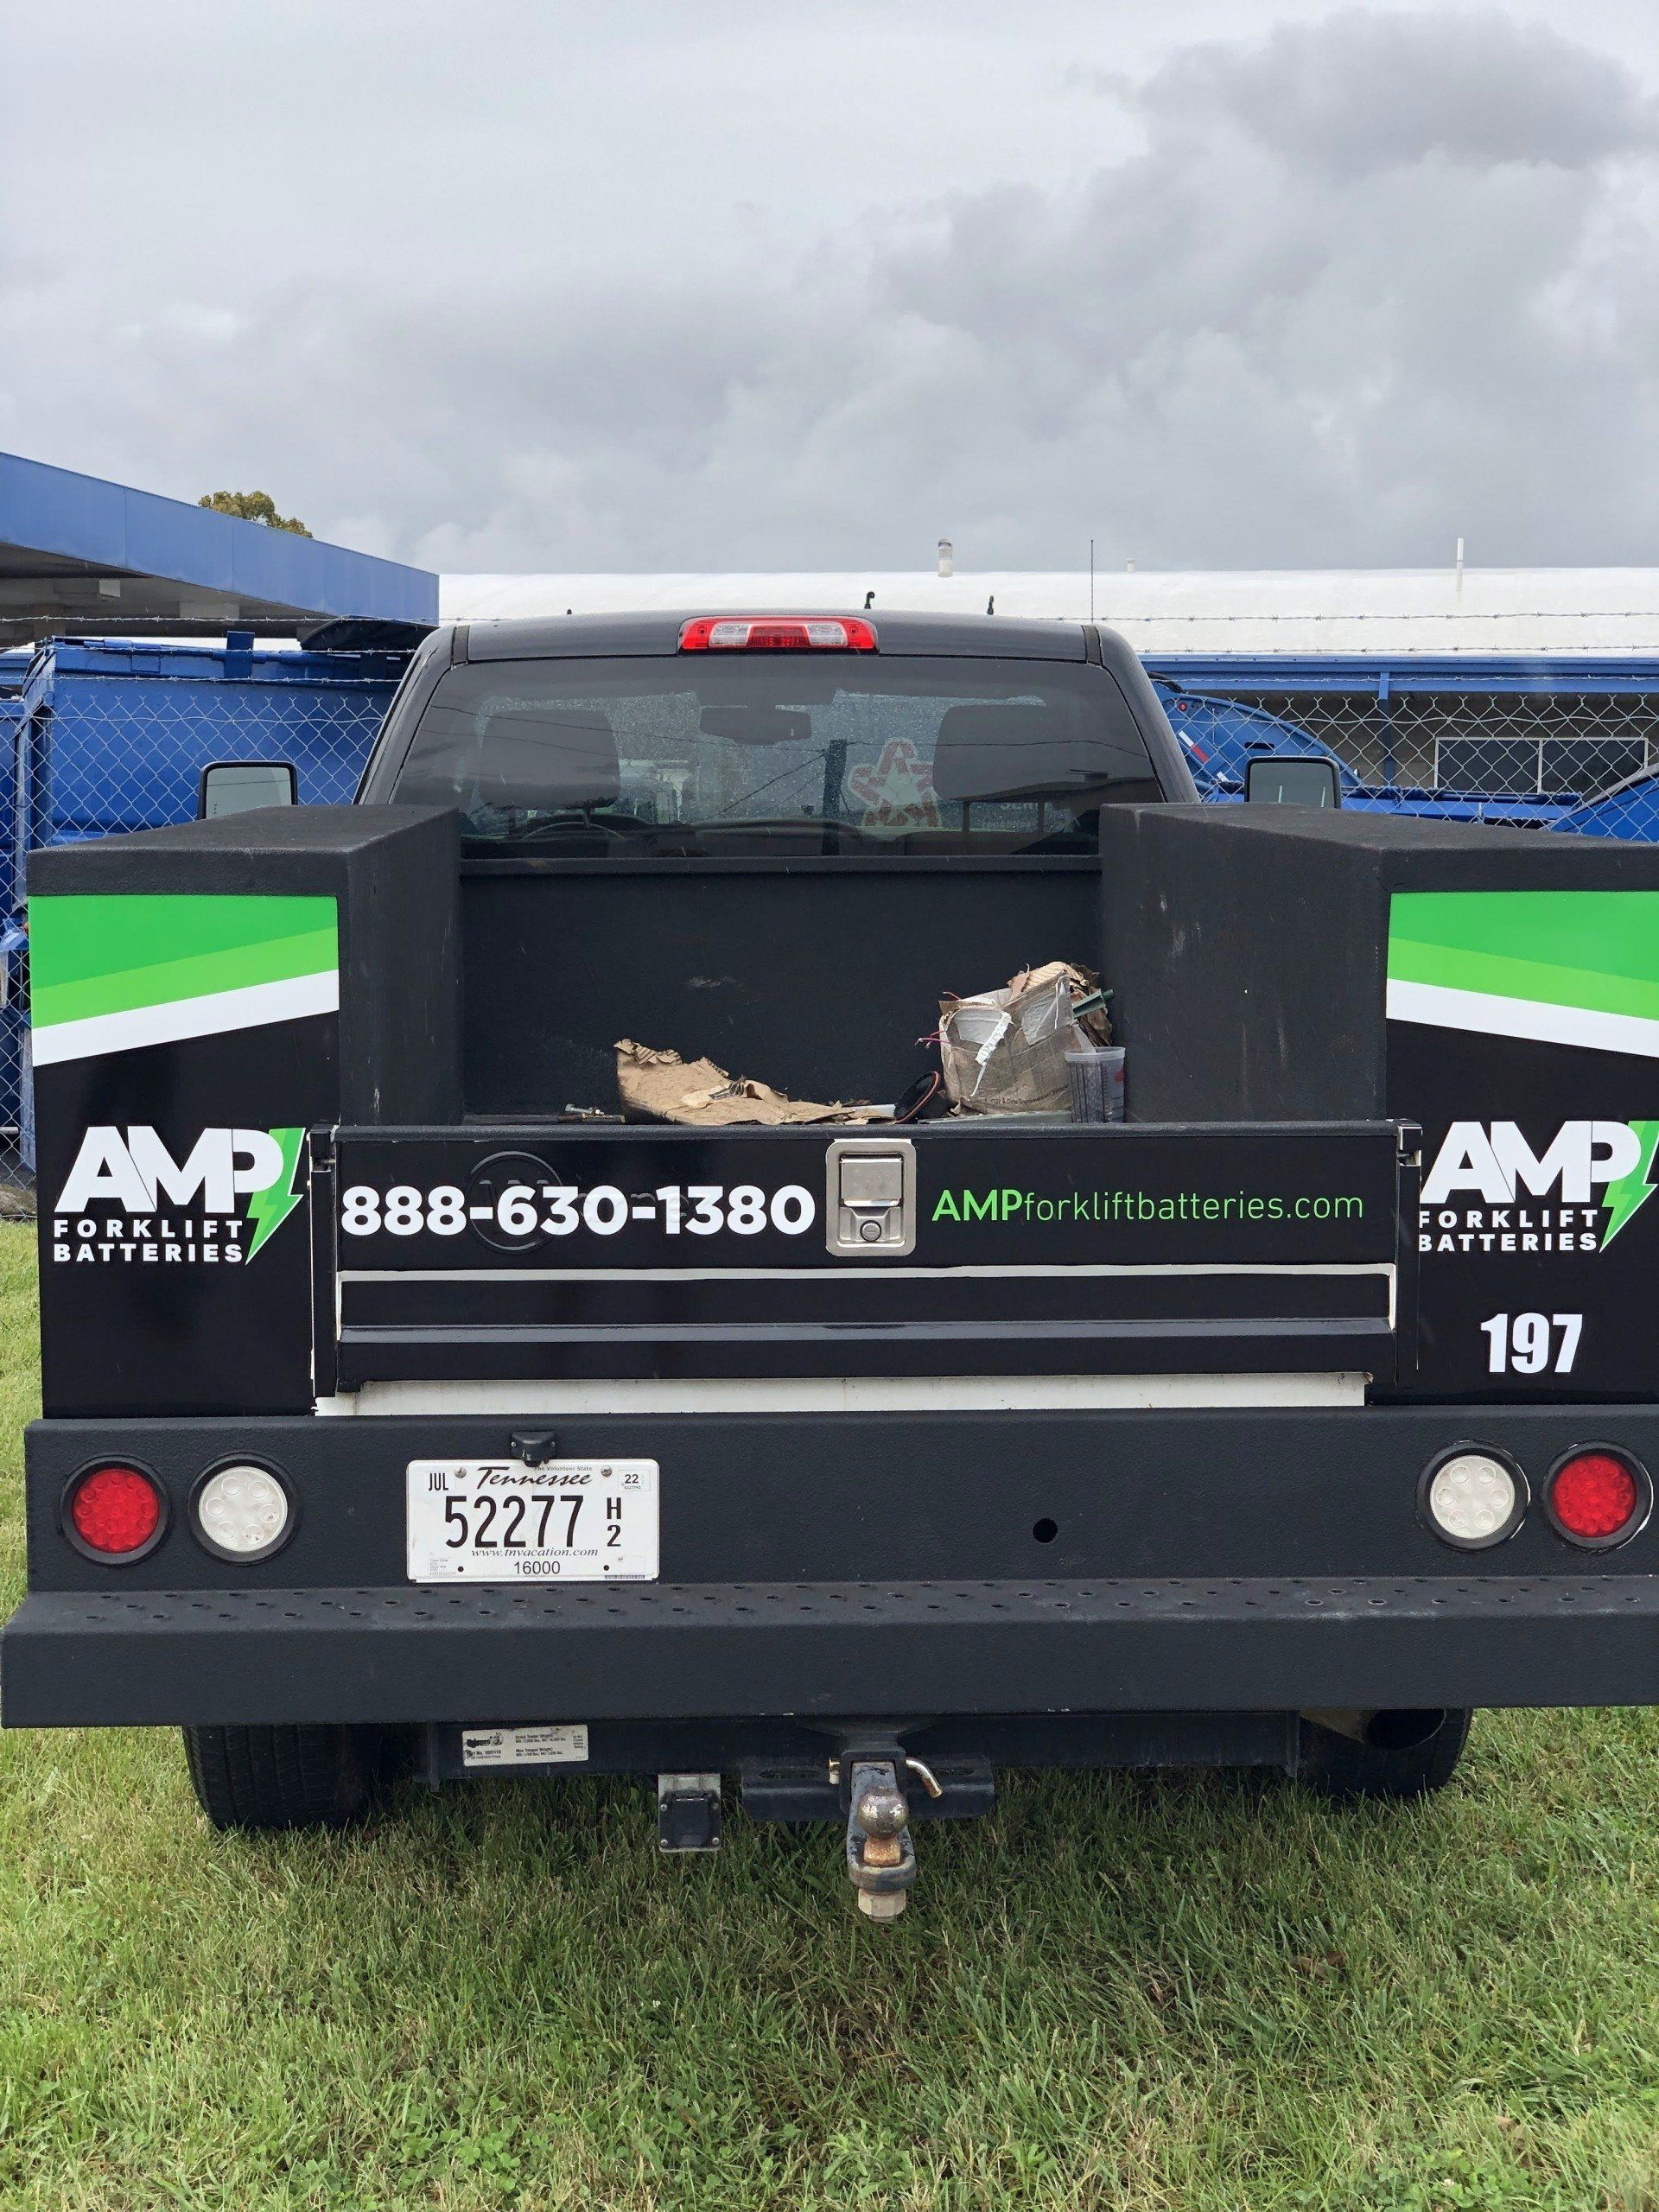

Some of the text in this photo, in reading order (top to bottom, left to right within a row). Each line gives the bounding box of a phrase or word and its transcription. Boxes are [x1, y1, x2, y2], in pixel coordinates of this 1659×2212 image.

[54, 1126, 284, 1214] AMP
[1420, 1121, 1642, 1204] AMP
[341, 1185, 815, 1236] 888-630-1380
[932, 1189, 1363, 1221] AMPforkliftbatteries.com
[54, 1219, 243, 1238] FORKLIFT
[1419, 1210, 1598, 1229] FORKLIFT
[1419, 1233, 1597, 1252] BATTERIES
[54, 1243, 243, 1262] BATTERIES
[1480, 1313, 1583, 1374] 197
[429, 1472, 449, 1491] JUL
[477, 1466, 593, 1490] Tennessee
[624, 1473, 639, 1484] 22
[446, 1496, 583, 1548] 52277
[472, 1548, 599, 1557] www.tnvacation.com
[514, 1560, 561, 1574] 16000
